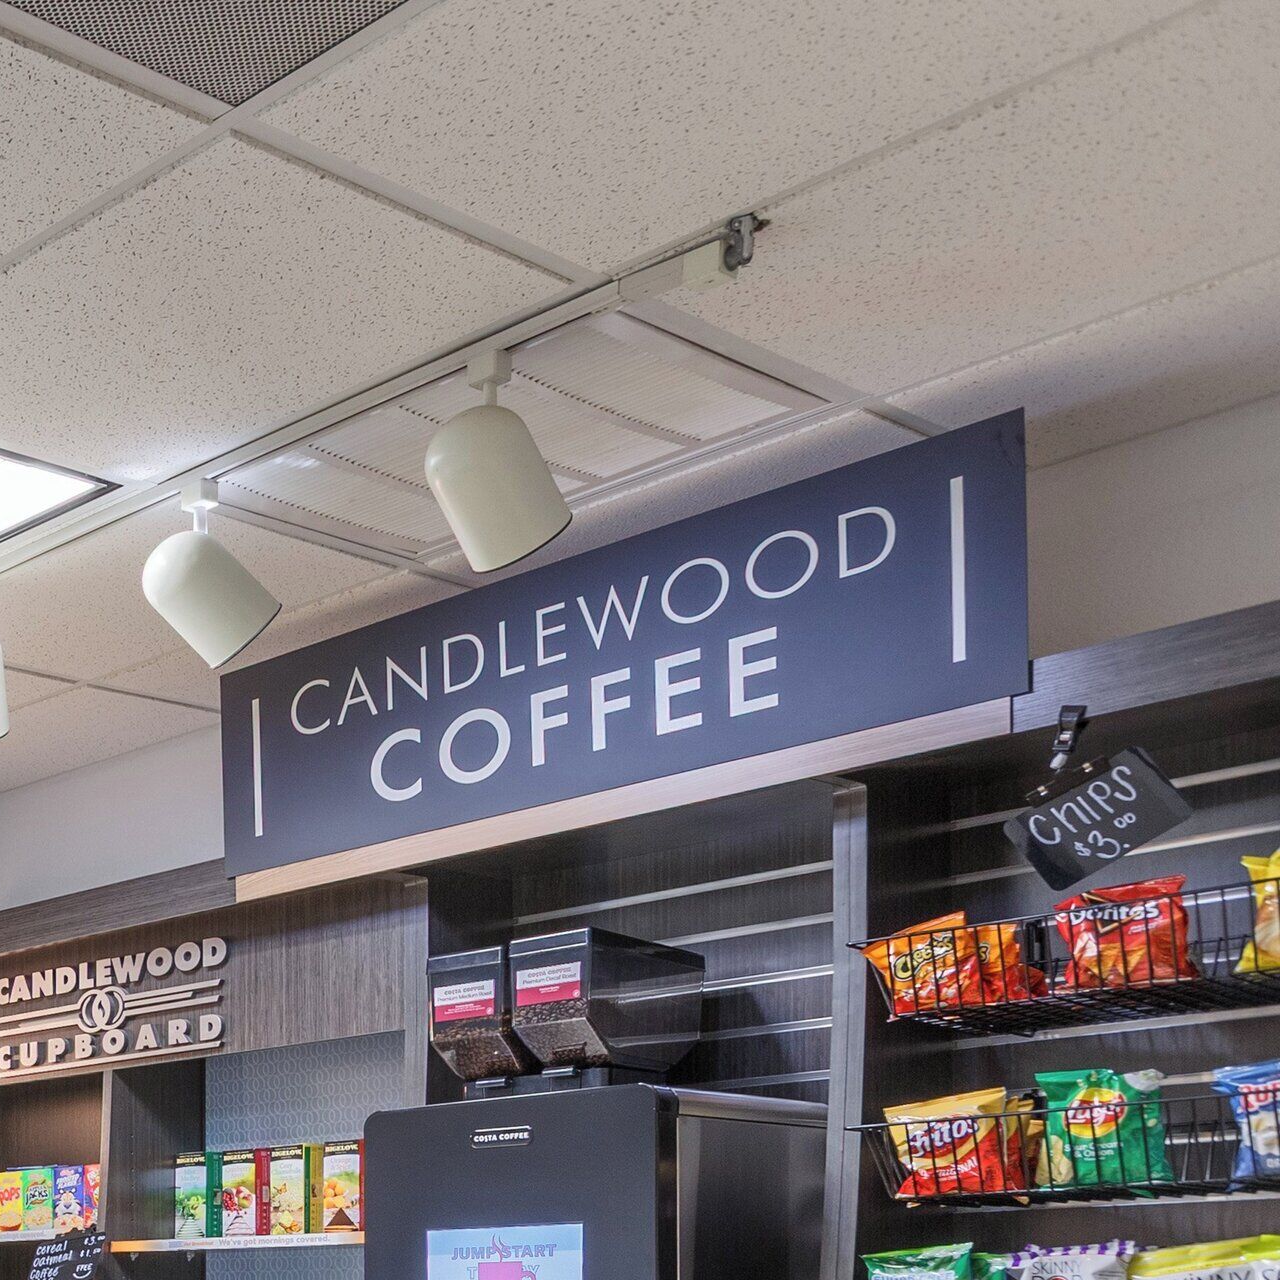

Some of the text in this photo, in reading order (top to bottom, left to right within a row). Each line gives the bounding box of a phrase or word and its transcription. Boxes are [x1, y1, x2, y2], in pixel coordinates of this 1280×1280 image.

[289, 506, 896, 736] CANDLEWOOD
[369, 626, 780, 802] COFFEE
[1071, 900, 1160, 925] Doritos
[473, 1131, 529, 1142] COSTA COFFEE
[219, 1235, 331, 1247] We've got mornings covered.
[451, 1243, 557, 1261] JUMP START
